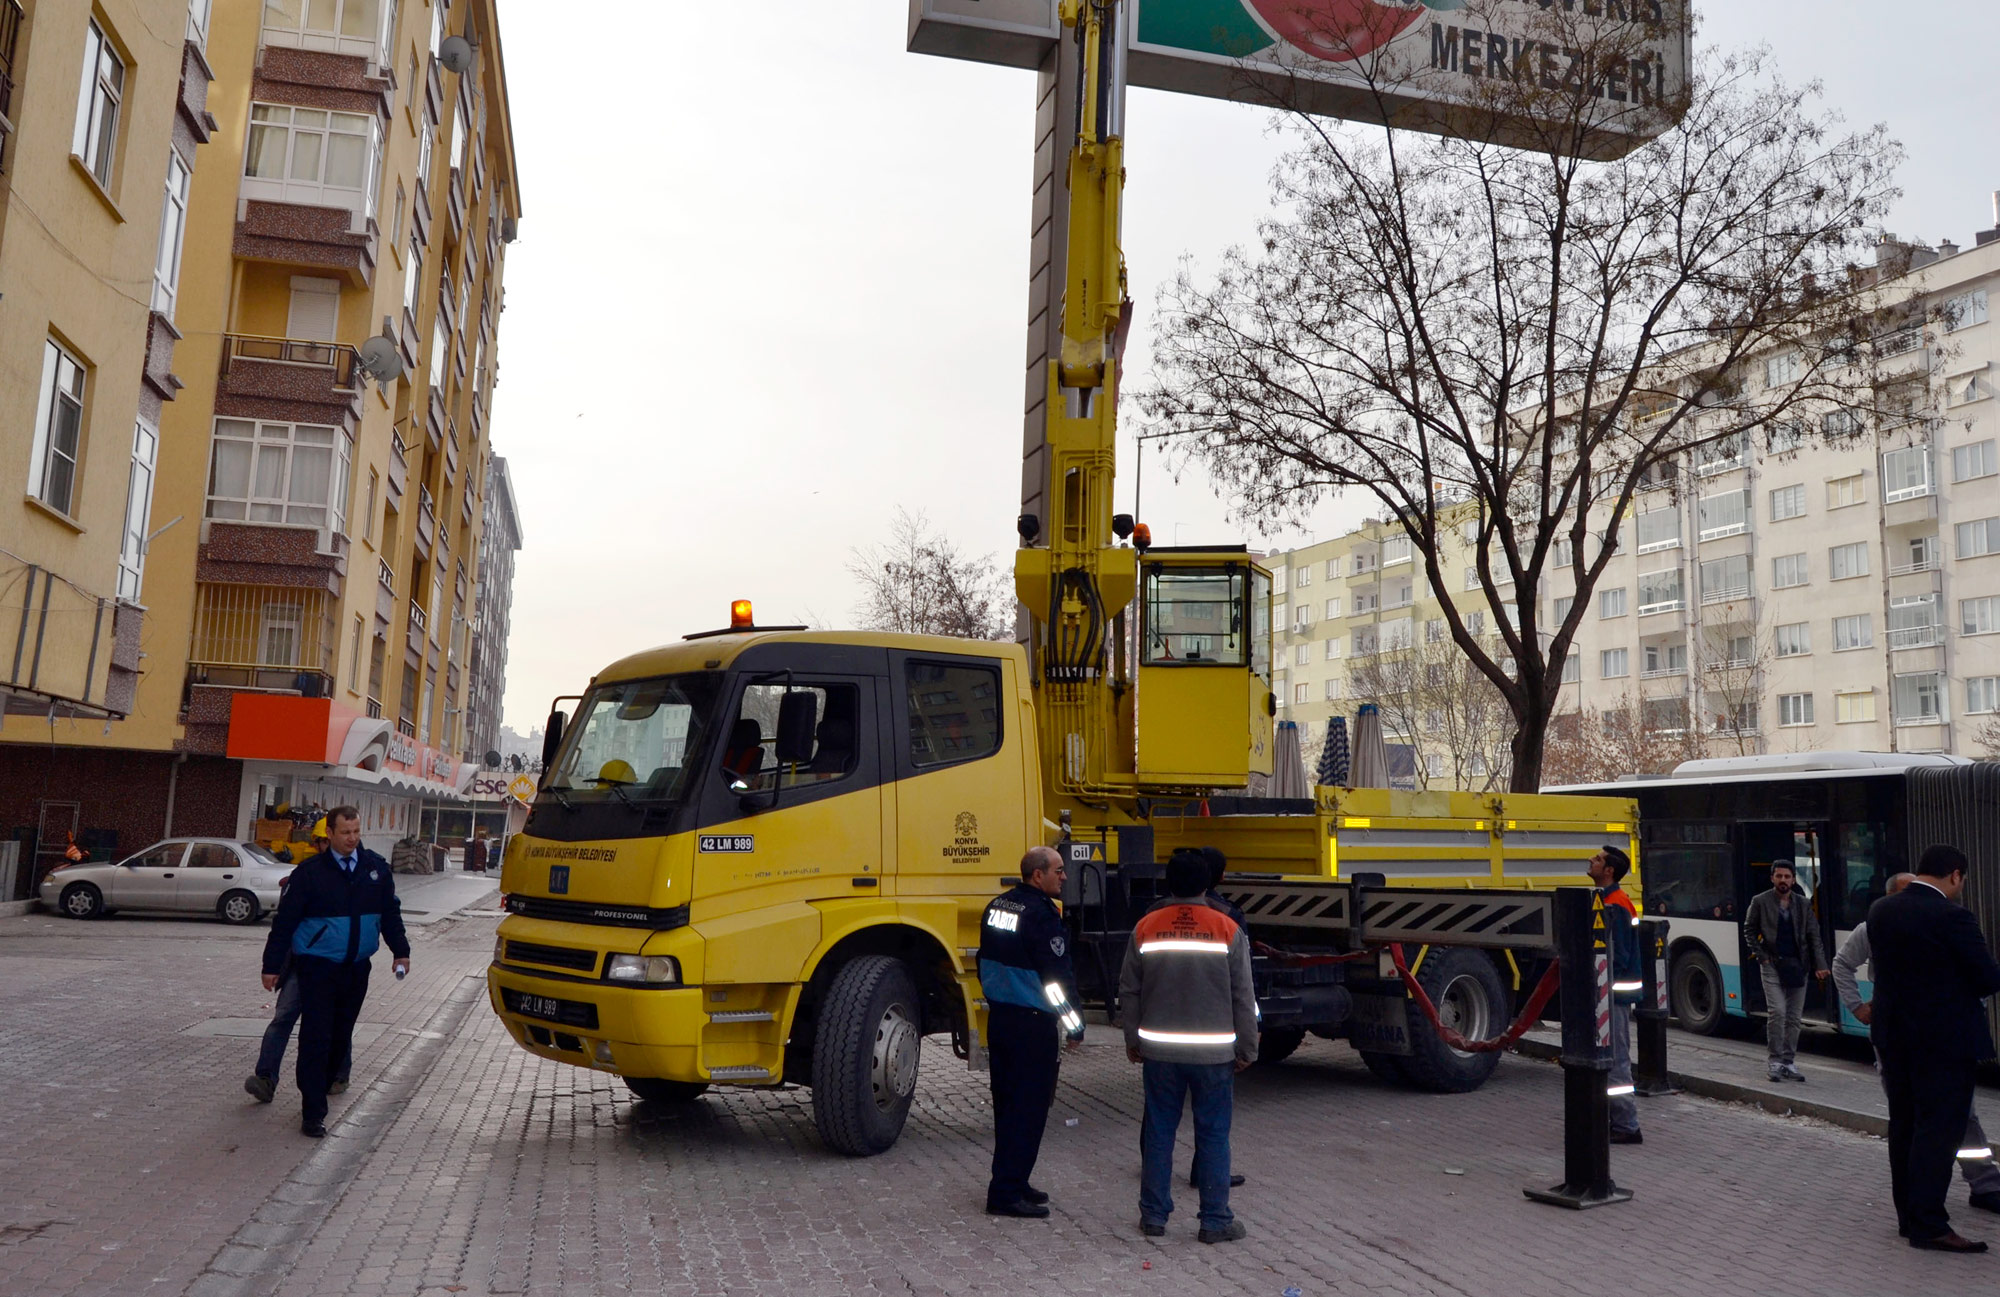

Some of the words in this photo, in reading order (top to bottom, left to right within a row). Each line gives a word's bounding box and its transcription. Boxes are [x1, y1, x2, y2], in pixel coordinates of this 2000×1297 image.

[702, 838, 715, 850] 42
[717, 838, 732, 850] LM
[734, 838, 752, 850] 989
[954, 837, 978, 845] KONYA
[578, 846, 618, 863] BELEDİYESİ
[942, 845, 990, 857] BÜYÜKŞEHİR
[1073, 845, 1090, 859] oil
[594, 909, 648, 921] PROFESYONEL
[1156, 930, 1176, 939] FEN
[543, 999, 557, 1016] 989
